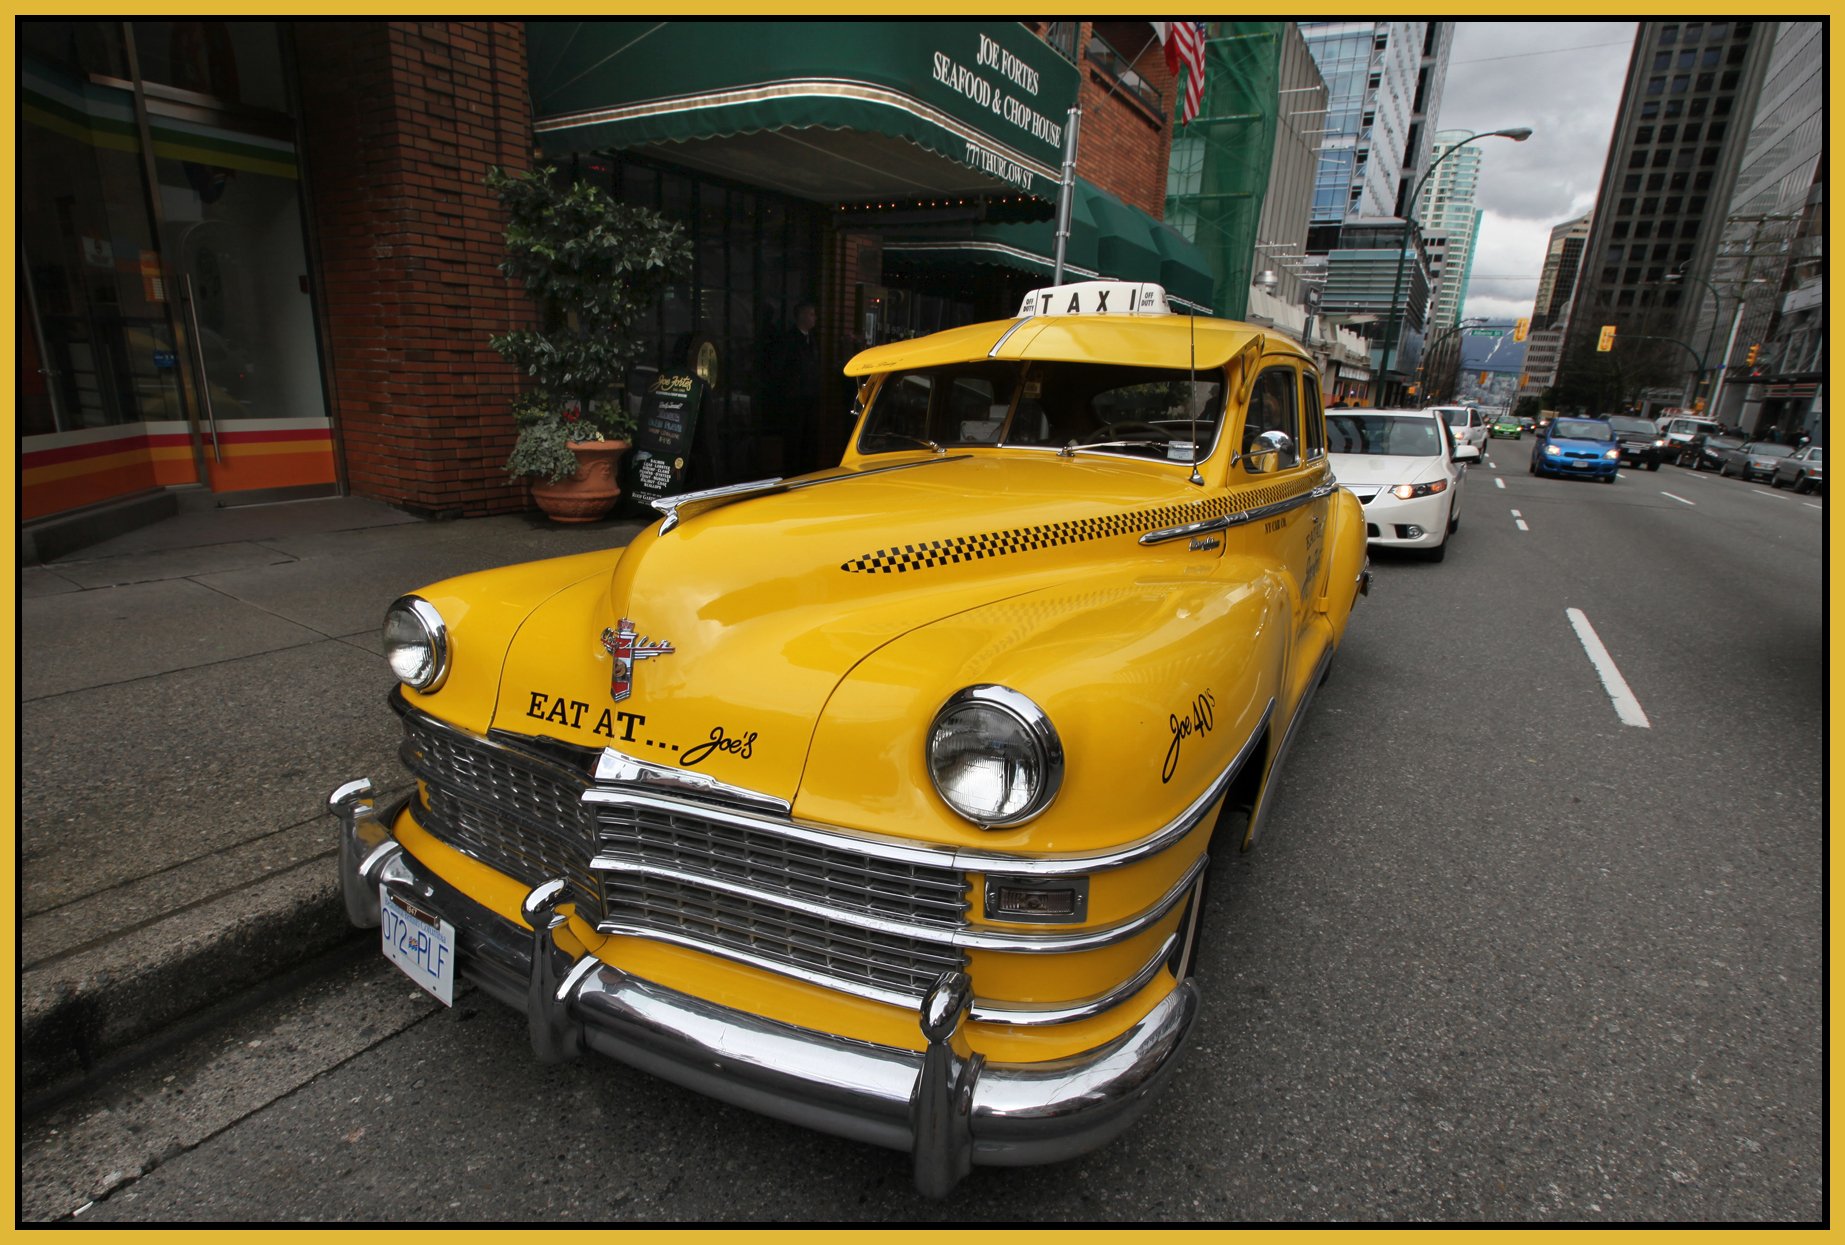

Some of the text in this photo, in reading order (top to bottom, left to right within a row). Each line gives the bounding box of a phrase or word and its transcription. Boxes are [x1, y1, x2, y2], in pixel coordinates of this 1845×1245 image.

[977, 33, 1039, 96] JOE FORTES
[933, 51, 1062, 149] SEAFOOD & CHOP HOUSE
[966, 142, 1034, 190] 777 THURLOW ST
[1022, 305, 1035, 313] DUTY
[1041, 289, 1137, 315] TAXI
[1141, 299, 1155, 307] DUTY
[1144, 291, 1154, 299] OFF
[526, 691, 589, 729] EAT
[679, 726, 758, 767] Joe's
[1162, 713, 1192, 784] Joe
